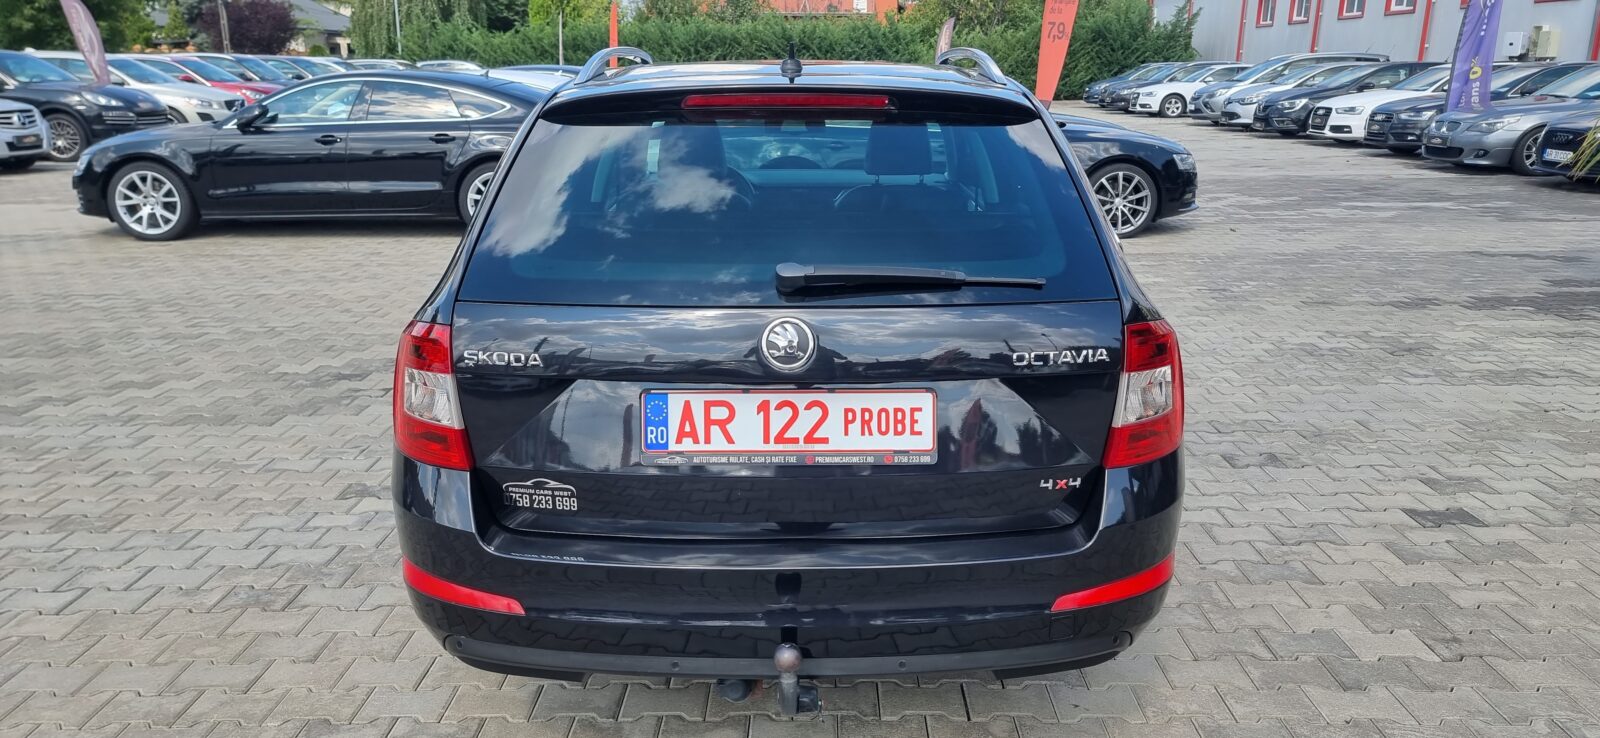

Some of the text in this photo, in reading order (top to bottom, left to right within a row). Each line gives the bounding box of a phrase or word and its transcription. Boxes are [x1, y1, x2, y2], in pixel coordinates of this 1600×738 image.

[1012, 348, 1110, 366] OCTAVIA
[675, 400, 923, 445] AR 122 PROBE
[647, 427, 667, 444] RO
[532, 495, 553, 509] 233
[555, 497, 578, 511] 699
